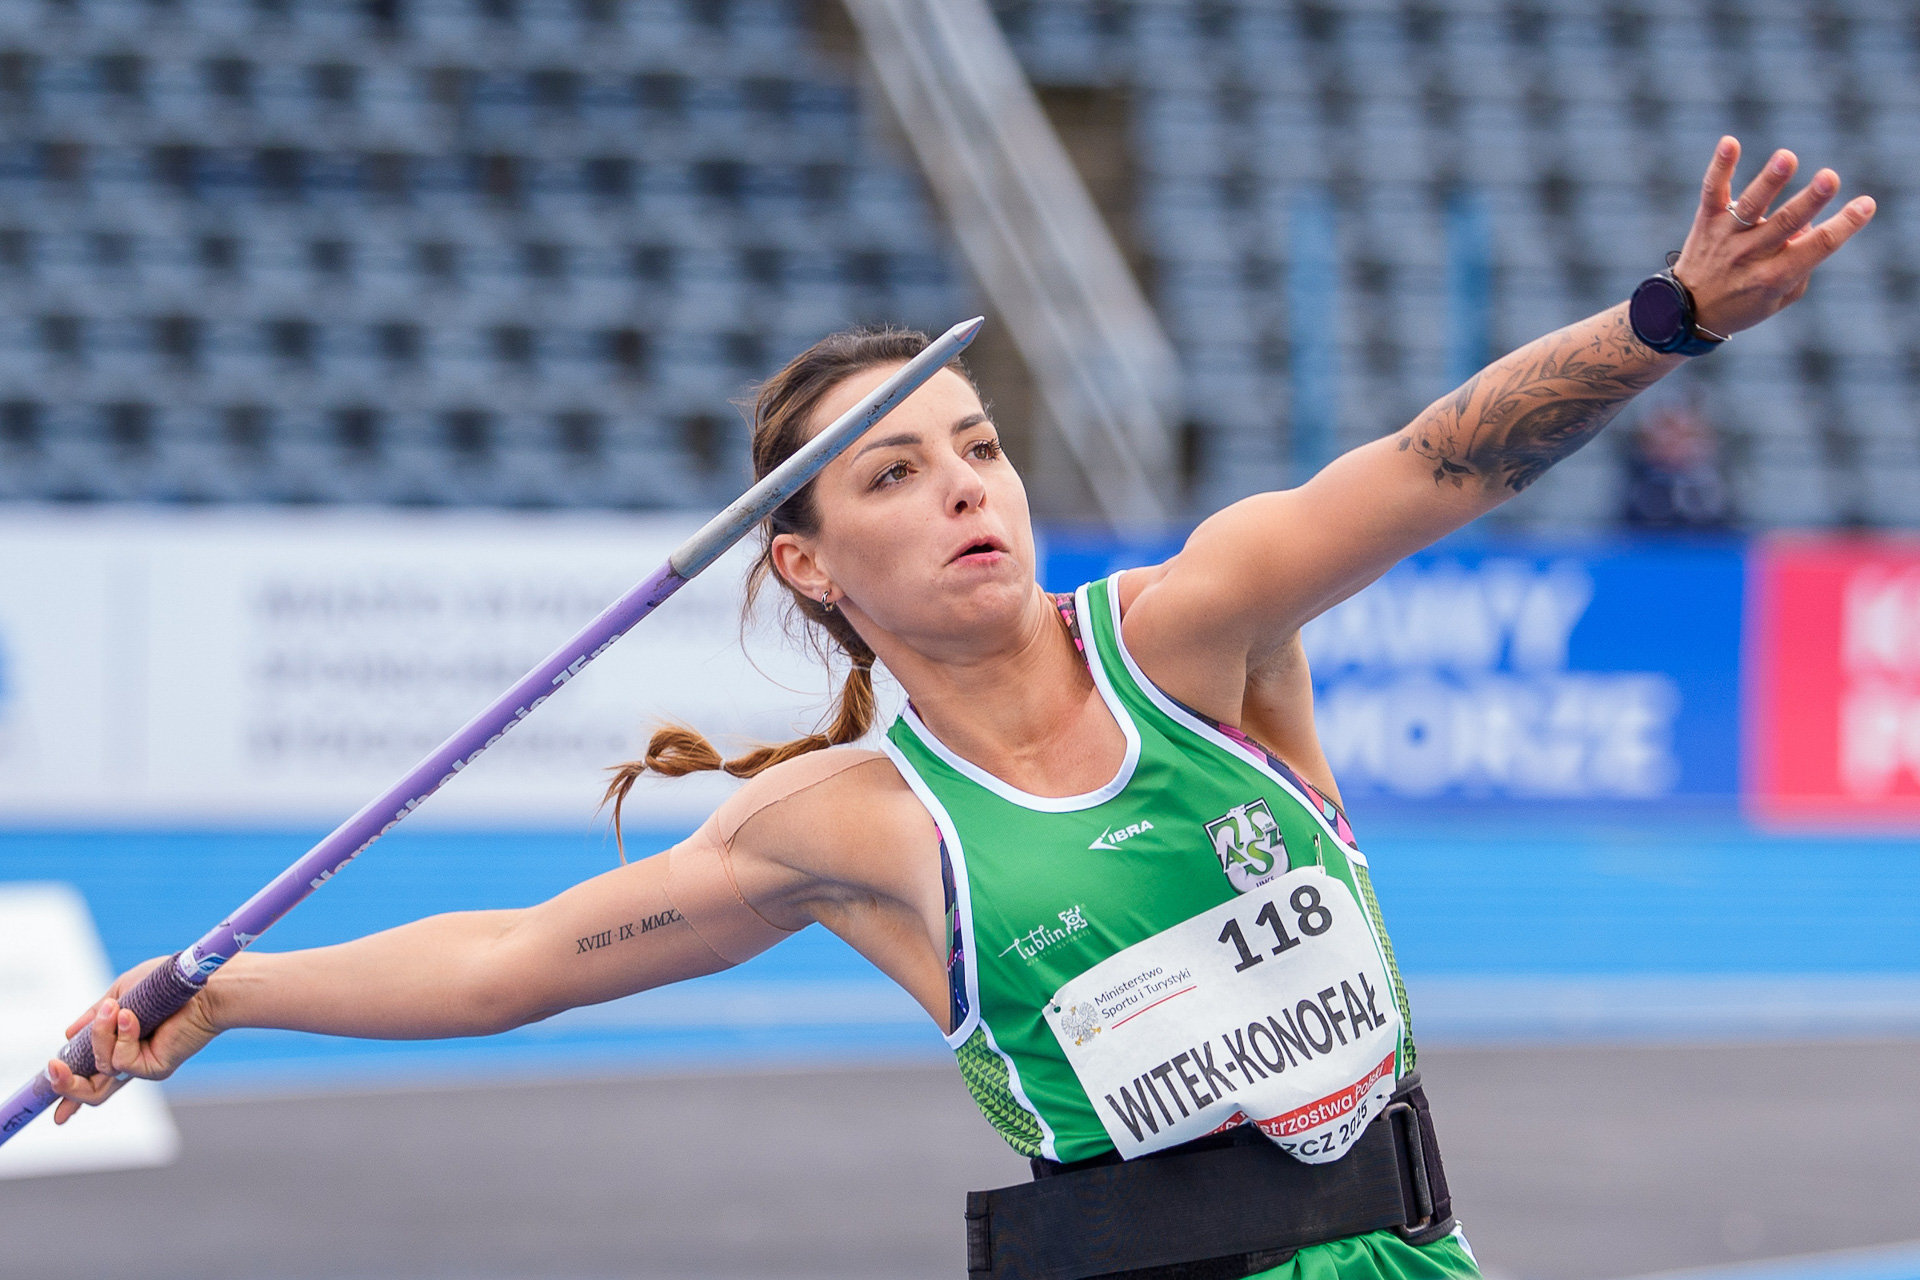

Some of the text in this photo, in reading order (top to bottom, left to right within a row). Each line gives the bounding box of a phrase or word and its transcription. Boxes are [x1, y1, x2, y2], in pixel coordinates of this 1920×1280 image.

[576, 929, 612, 955] XVIII
[619, 923, 635, 942] IX
[1217, 884, 1333, 973] 118
[1094, 966, 1163, 1007] Ministerstwo
[1101, 994, 1139, 1020] Sportu
[1143, 967, 1192, 995] Turystyki
[1104, 971, 1387, 1143] WITEK-KONOFAŁ
[1338, 1099, 1368, 1146] 2025
